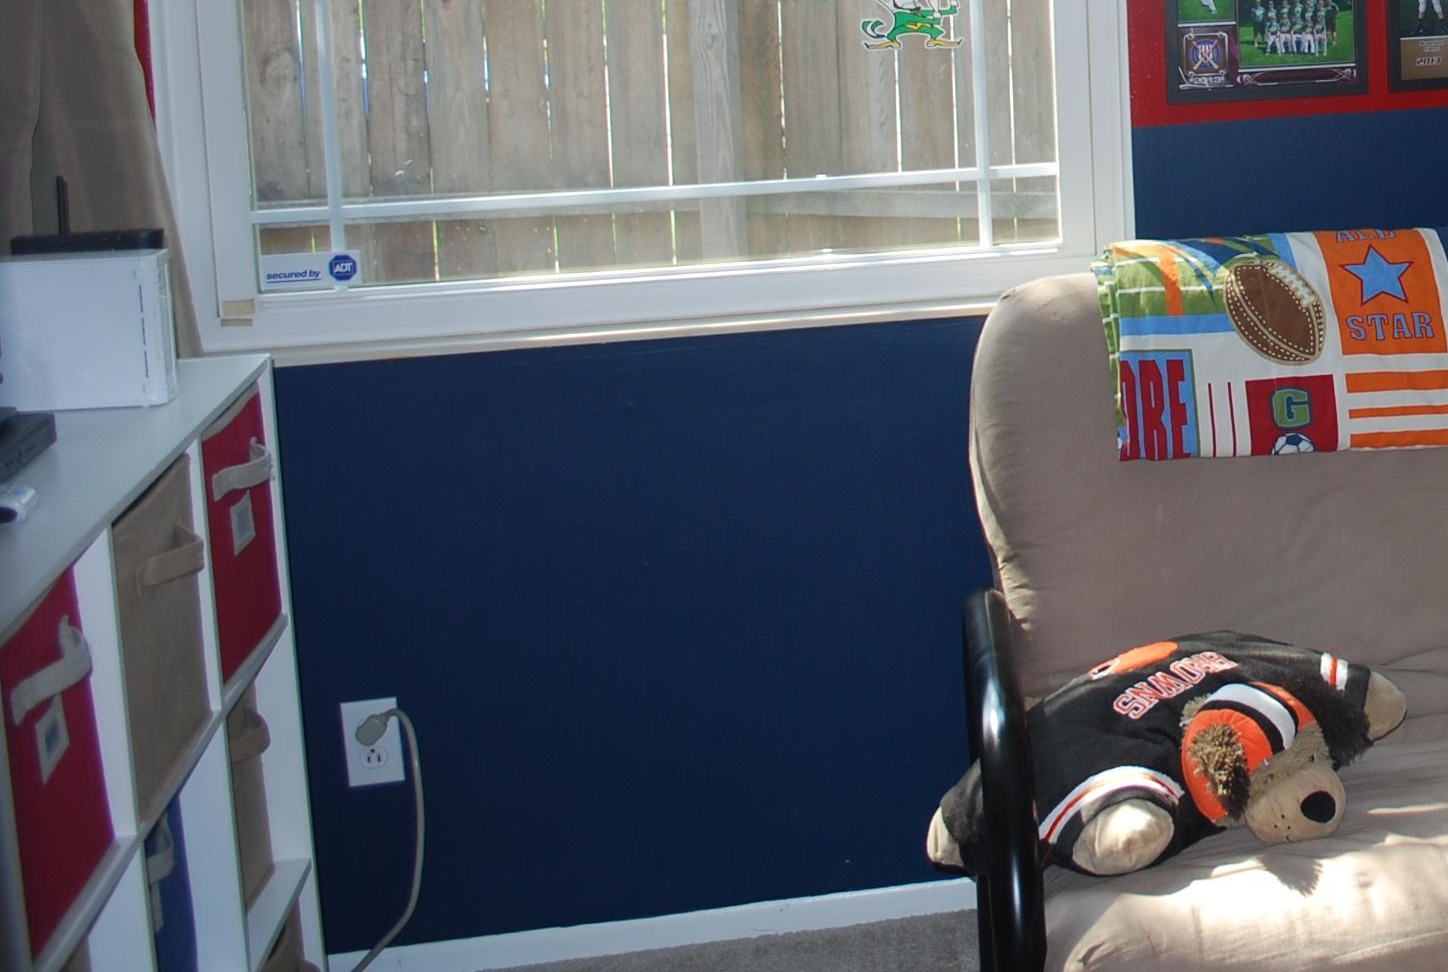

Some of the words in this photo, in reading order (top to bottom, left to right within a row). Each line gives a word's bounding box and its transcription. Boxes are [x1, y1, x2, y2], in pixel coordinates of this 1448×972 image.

[266, 270, 307, 280] secured
[308, 269, 320, 278] by
[333, 262, 353, 274] ADT
[1345, 311, 1435, 341] STAR
[1272, 387, 1312, 428] G
[1112, 651, 1239, 720] BROWNS
